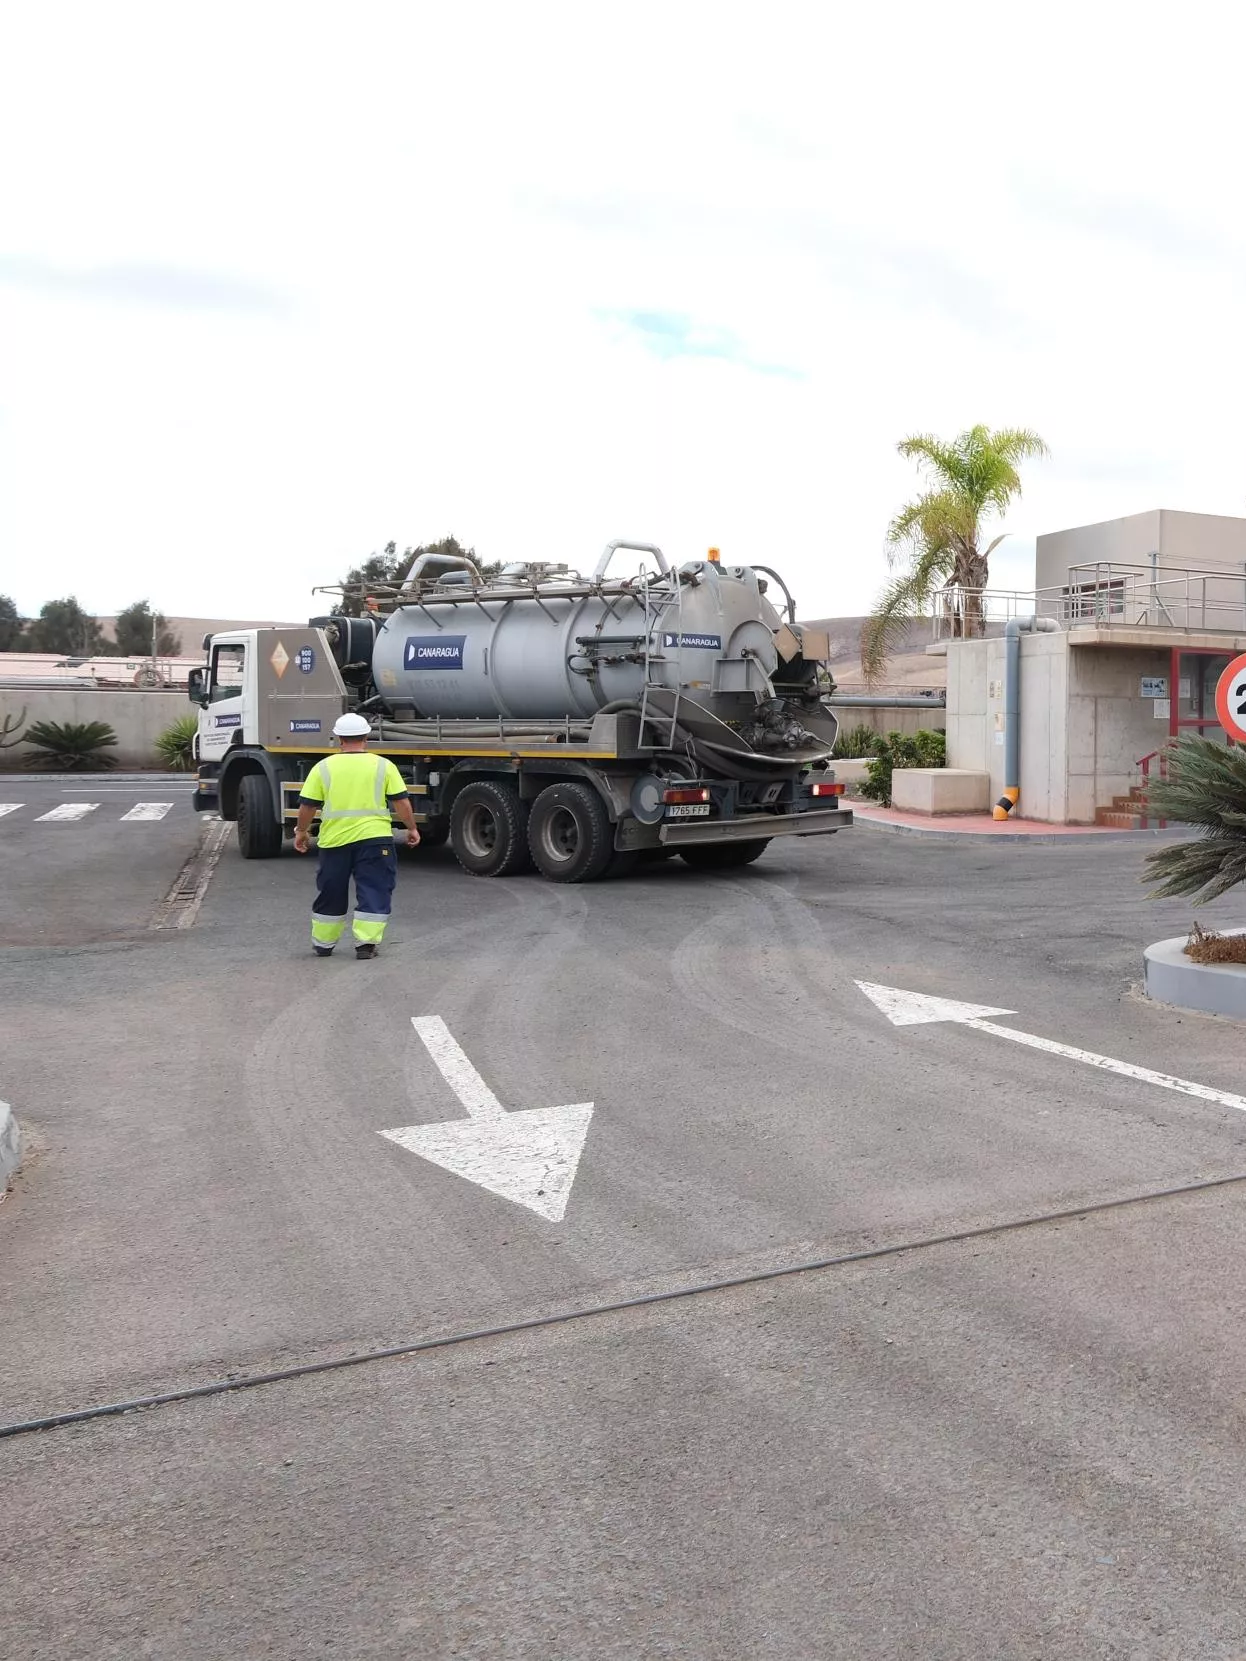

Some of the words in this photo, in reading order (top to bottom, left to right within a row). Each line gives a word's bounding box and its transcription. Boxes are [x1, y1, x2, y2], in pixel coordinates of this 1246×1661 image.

[417, 647, 460, 658] CANARAGUA
[672, 806, 690, 816] 1765
[692, 805, 709, 815] FFF
